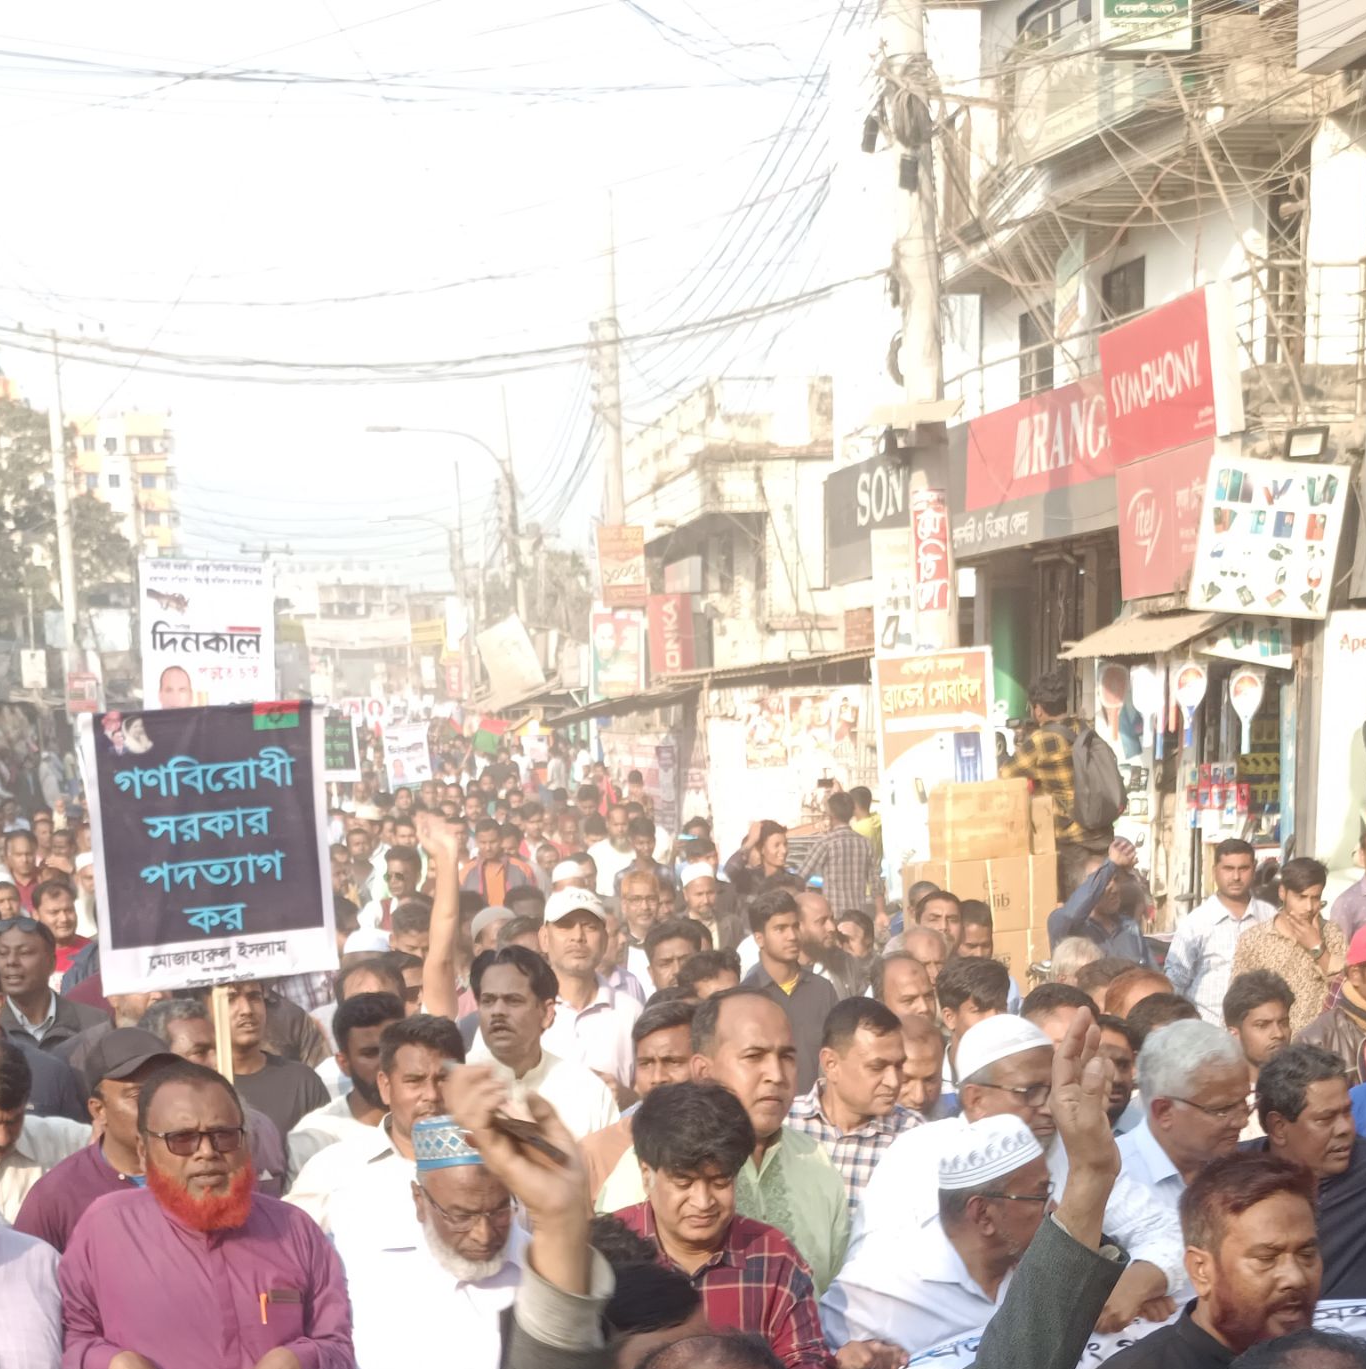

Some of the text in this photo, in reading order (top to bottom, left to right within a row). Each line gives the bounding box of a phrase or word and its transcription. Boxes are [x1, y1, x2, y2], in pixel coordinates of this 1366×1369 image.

[1111, 341, 1200, 418] SYMPHONY
[1031, 394, 1111, 476] RANG
[151, 620, 262, 655] দিনকাল
[114, 746, 295, 799] গণবিরোধী
[142, 806, 273, 844] সরকার
[140, 850, 286, 893] পদত্যাগ
[182, 902, 247, 934] কর
[236, 940, 287, 957] ইসলাম
